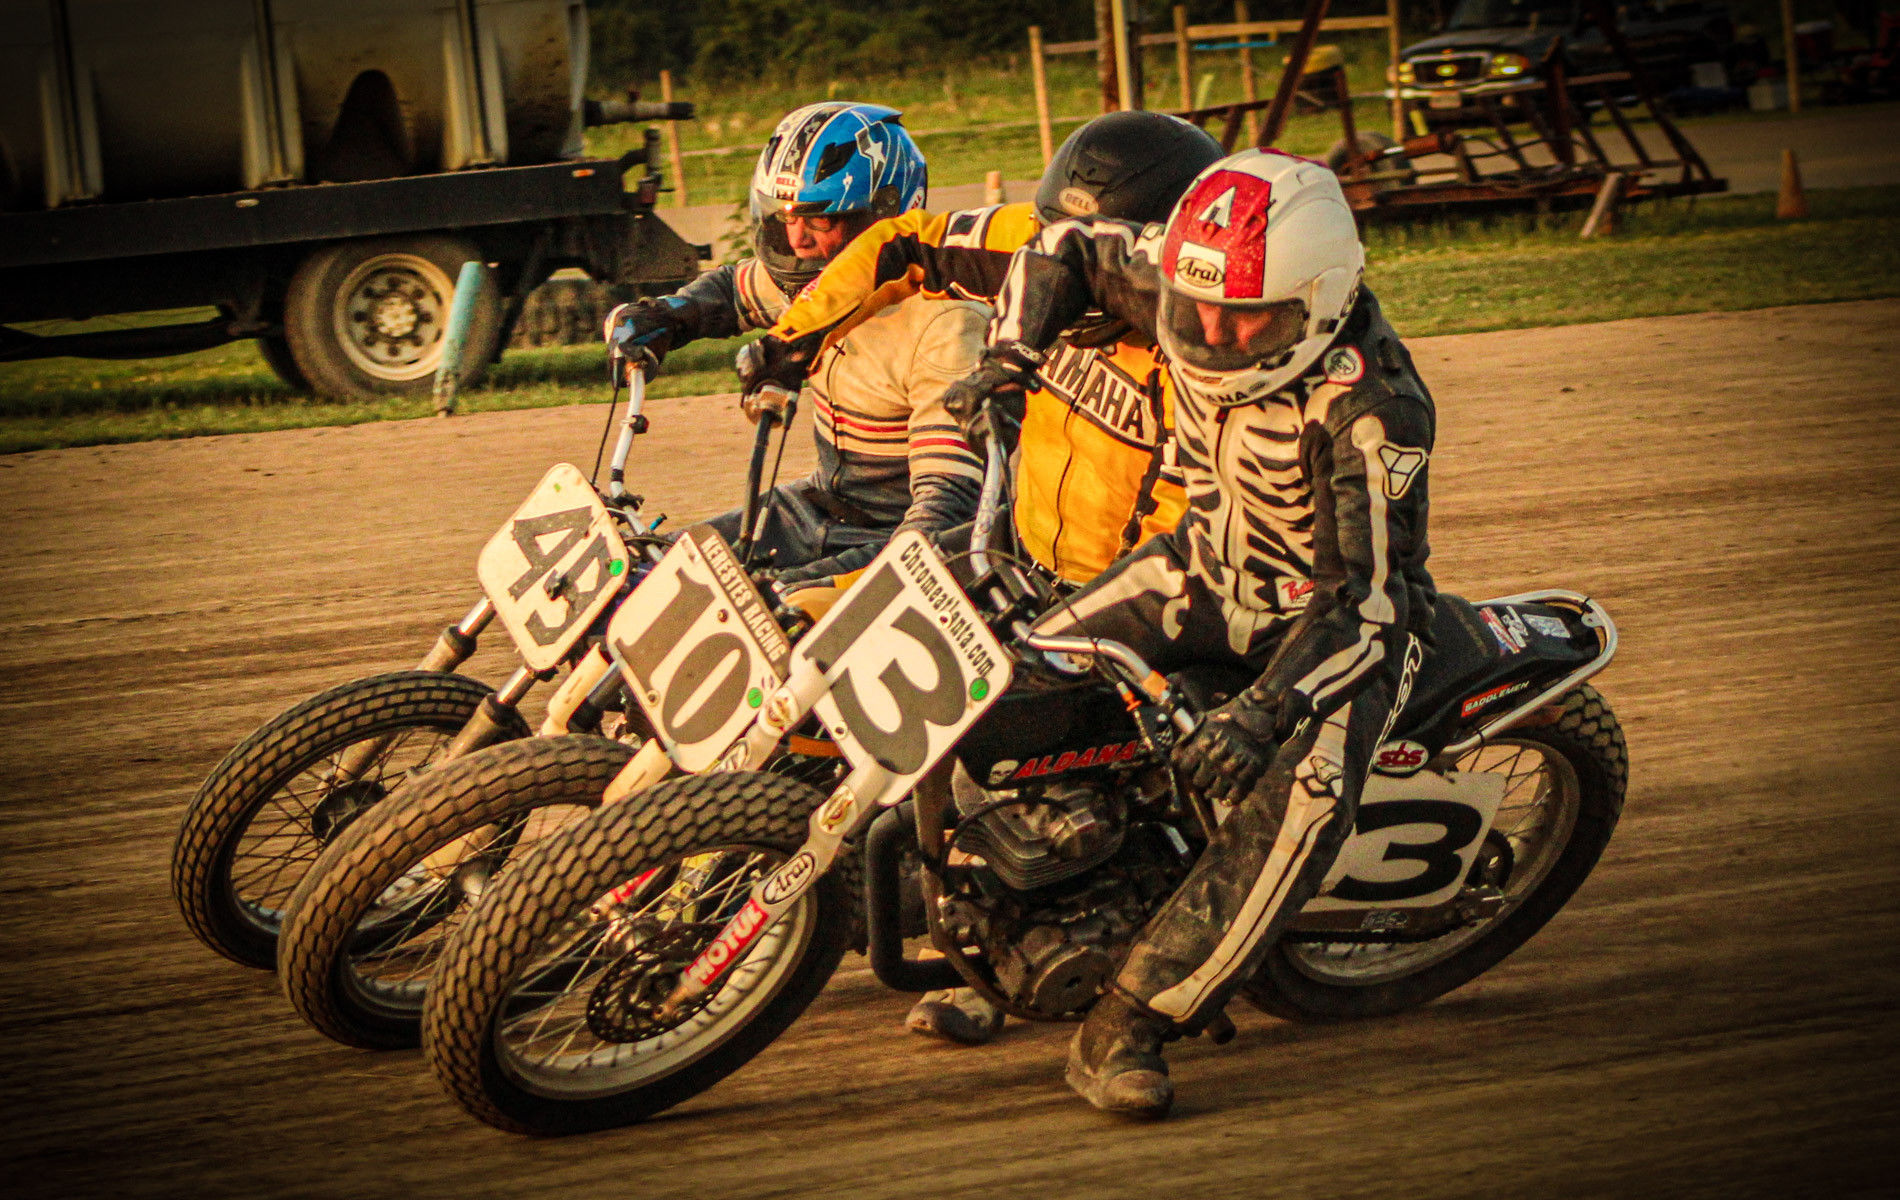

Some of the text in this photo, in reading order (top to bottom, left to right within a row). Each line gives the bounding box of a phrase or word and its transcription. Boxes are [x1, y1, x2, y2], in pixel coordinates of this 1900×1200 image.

[776, 177, 797, 188] BELL
[1177, 260, 1220, 282] Arai
[1039, 343, 1145, 439] AMAHA
[701, 535, 787, 663] KERESTES RACING
[615, 567, 751, 745] 10
[802, 561, 966, 775] 13
[1012, 740, 1138, 780] ALDANA
[1377, 742, 1425, 766] sbs
[769, 852, 810, 899] Arai
[688, 903, 765, 982] MOTUL
